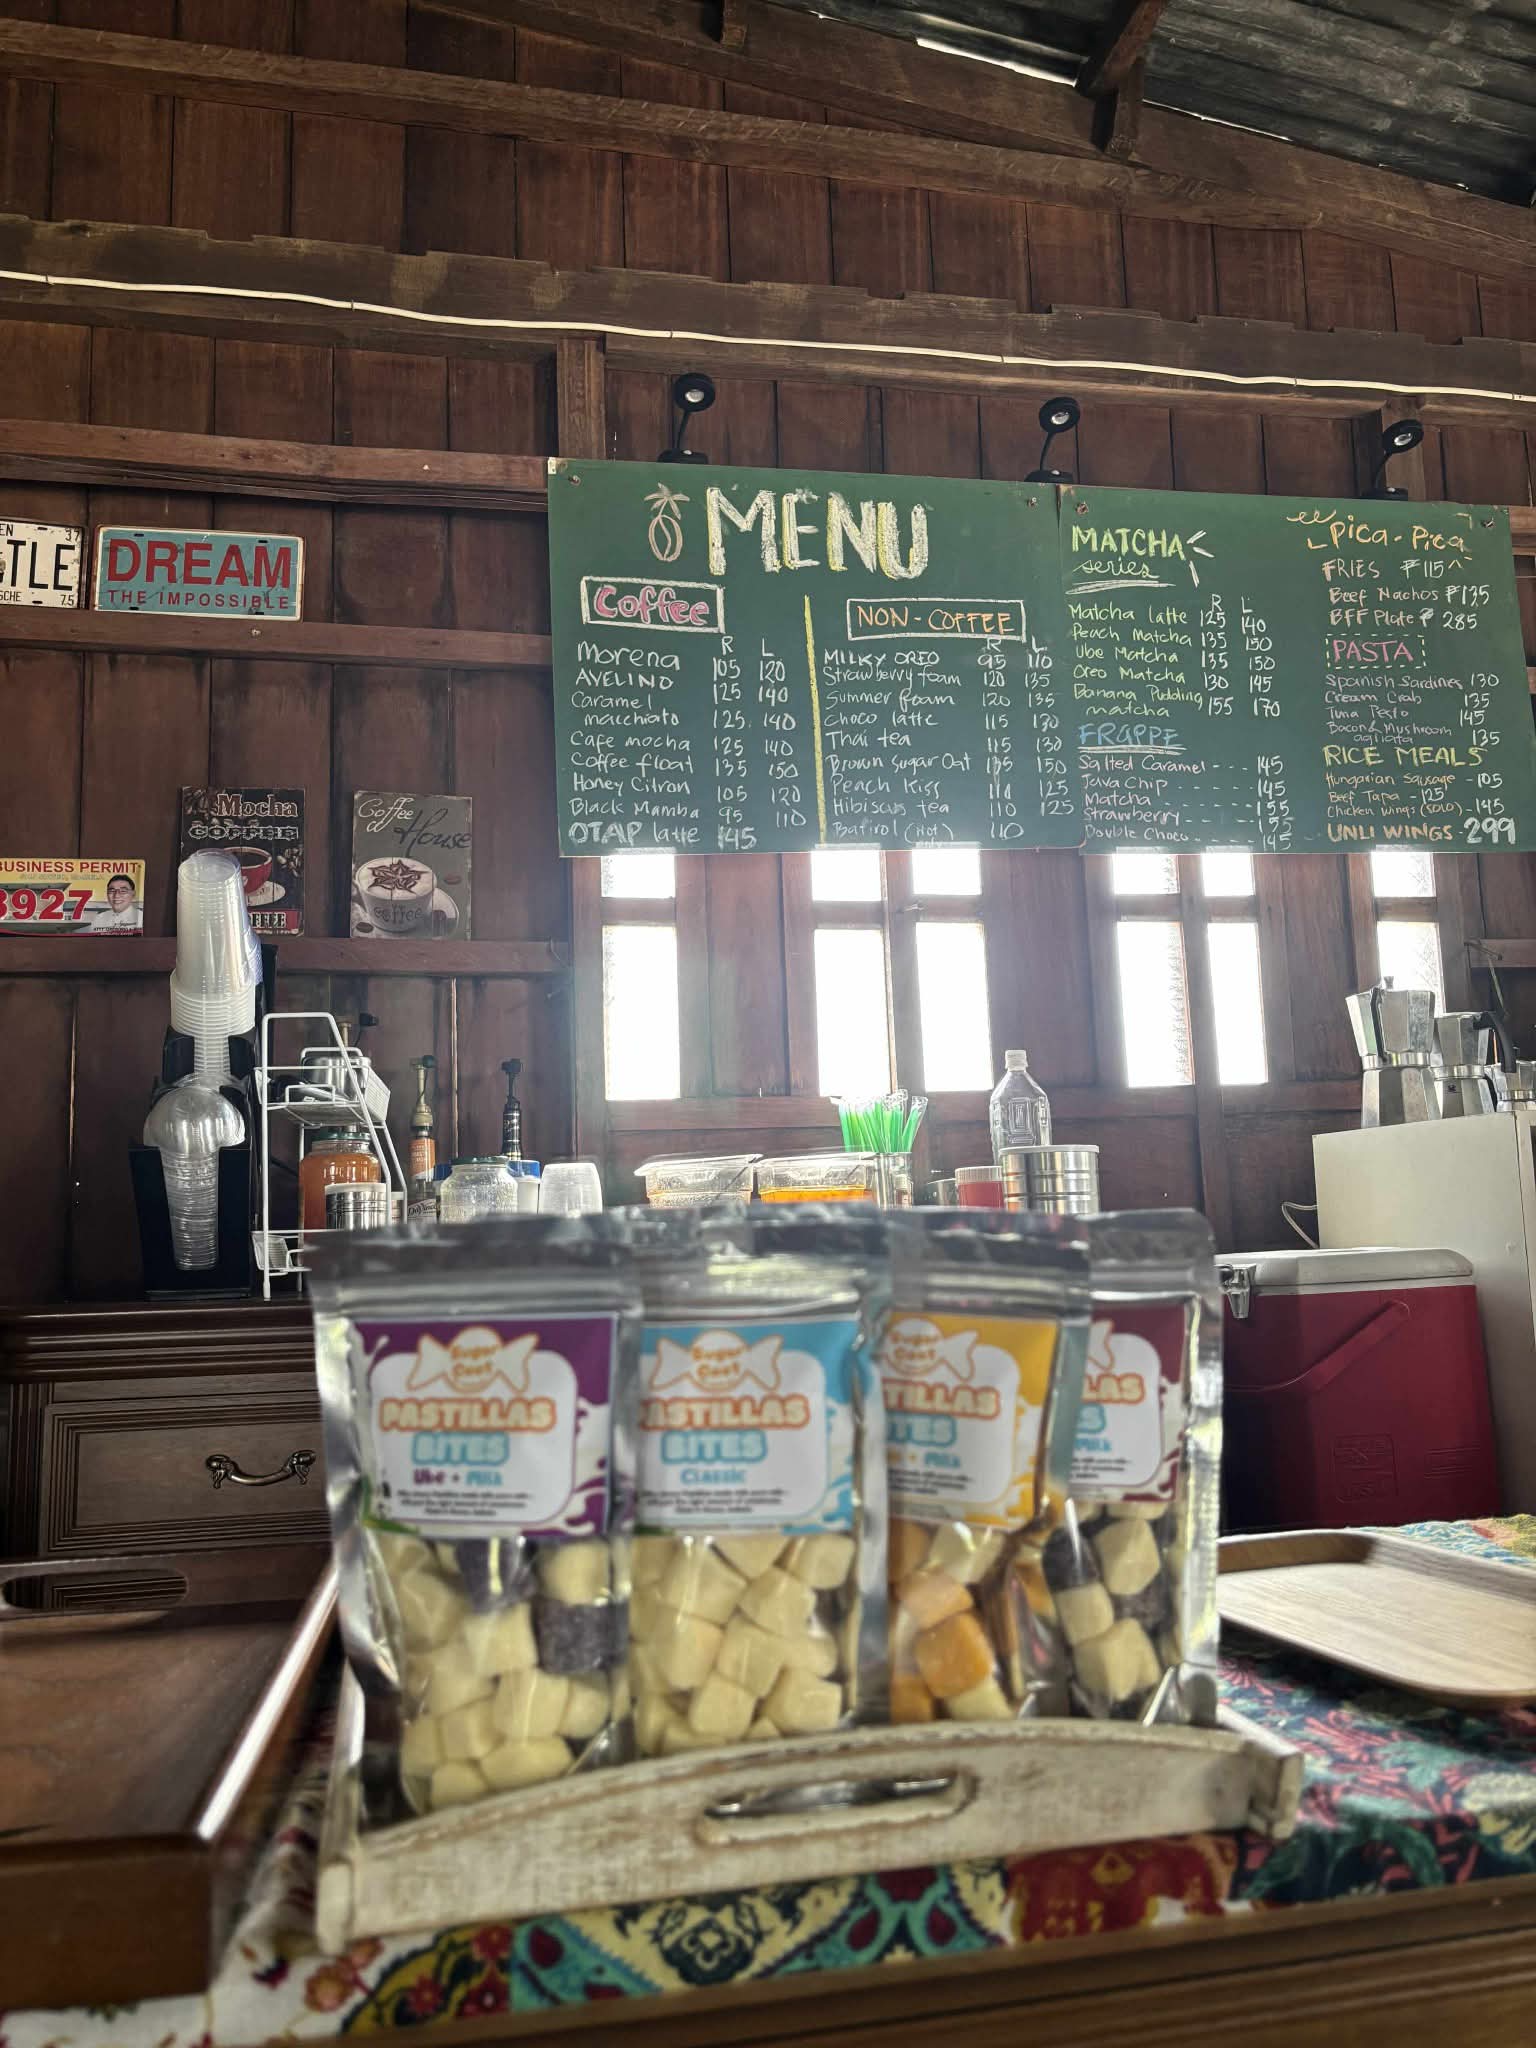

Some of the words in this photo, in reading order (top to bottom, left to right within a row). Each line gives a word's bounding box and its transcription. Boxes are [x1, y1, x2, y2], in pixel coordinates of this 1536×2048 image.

[65, 527, 80, 541] 37
[706, 487, 929, 580] MENU
[1072, 525, 1186, 561] MATCHA
[0, 539, 76, 592] TLE
[107, 538, 291, 588] DREAM
[1073, 558, 1160, 579] series
[1322, 559, 1379, 581] FRIES
[60, 594, 75, 606] 75
[107, 589, 146, 603] THE
[159, 592, 289, 609] IMPOSSIBLE
[593, 586, 710, 626] Coffee
[1330, 587, 1368, 606] Beef
[1378, 587, 1439, 602] Nachos
[1068, 604, 1135, 621] Matcha
[1149, 606, 1187, 624] latte
[1200, 610, 1226, 628] 125
[1242, 616, 1266, 635] 140
[1330, 609, 1369, 626] BFF
[1375, 609, 1414, 626] Plate
[1443, 612, 1477, 629] 285
[722, 636, 733, 655] R
[1072, 623, 1120, 642] Peach
[1132, 628, 1192, 647] Matcha
[1201, 631, 1227, 651] 135
[1246, 637, 1272, 652] 150
[577, 641, 680, 671] Morena
[713, 657, 740, 680] 105
[759, 660, 785, 683] 120
[824, 649, 885, 666] MILKY
[895, 652, 939, 666] OREO
[978, 654, 1006, 669] 95
[1027, 654, 1052, 669] 110
[1076, 645, 1104, 659] Ube
[1114, 646, 1178, 663] Matcha
[1202, 651, 1229, 670] 135
[1249, 655, 1275, 671] 150
[1333, 639, 1413, 662] PASTA
[576, 668, 673, 689] AVELINO
[713, 683, 740, 704] 125
[758, 686, 787, 706] 140
[823, 666, 913, 689] Strawberry
[918, 666, 962, 687] foam
[984, 672, 1005, 687] 120
[1025, 672, 1050, 689] 135
[1073, 667, 1107, 679] Oreo
[1120, 666, 1186, 685] Matcha
[1203, 674, 1229, 691] 130
[1250, 676, 1272, 693] 145
[1326, 675, 1395, 692] Spanish
[1400, 675, 1463, 689] Sardines
[1470, 673, 1499, 687] 130
[571, 691, 652, 710] Caramel
[826, 691, 891, 710] Summer
[982, 693, 1010, 707] 120
[1028, 693, 1055, 708] 135
[1073, 683, 1137, 701] Banana
[1150, 687, 1203, 710] Pudding
[1209, 696, 1233, 716] 155
[1254, 696, 1280, 717] 170
[1085, 704, 1170, 717] matcha
[1324, 692, 1377, 703] Cream
[1387, 691, 1422, 705] Crab
[1464, 693, 1490, 708] 135
[713, 710, 745, 729] 125
[764, 712, 796, 730] 140
[892, 712, 938, 726] latte
[985, 714, 1008, 729] 115
[1033, 714, 1059, 732] 130
[1327, 707, 1359, 719] Tuna
[1371, 707, 1409, 719] Pesto
[1460, 709, 1485, 727] 145
[826, 731, 868, 749] Thai
[878, 728, 911, 746] tea
[988, 737, 1011, 752] 115
[1037, 737, 1062, 752] 130
[1079, 723, 1182, 747] FRAPPE
[1384, 723, 1452, 736] Mushroom
[1473, 729, 1501, 747] 135
[571, 731, 615, 753] Cafe
[625, 735, 690, 751] mocha
[714, 736, 743, 756] 125
[765, 739, 793, 755] 140
[571, 752, 630, 773] Coffee
[636, 753, 693, 777] float
[716, 757, 746, 777] 135
[769, 762, 798, 779] 150
[826, 754, 884, 774] Brown
[942, 752, 971, 771] Oat
[1037, 757, 1067, 773] 150
[1079, 754, 1133, 772] Salted
[1142, 757, 1206, 774] Caramel
[1258, 755, 1284, 774] 145
[1322, 745, 1383, 766] RICE
[1395, 747, 1488, 766] MEALS
[573, 772, 624, 796] Honey
[632, 777, 690, 794] Citron
[718, 786, 747, 803] 105
[771, 786, 800, 806] 120
[832, 773, 891, 796] Peach
[1040, 779, 1069, 798] 125
[1082, 774, 1120, 789] Java
[1124, 774, 1167, 792] Chip
[1258, 780, 1286, 798] 145
[1326, 773, 1395, 786] Hungarian
[216, 794, 299, 817] Mocha
[833, 798, 905, 817] Hibiscus
[917, 799, 950, 818] tea
[991, 802, 1016, 817] 110
[1041, 800, 1074, 816] 125
[1085, 792, 1152, 807] Matcha
[1257, 800, 1289, 817] 155
[1328, 791, 1354, 804] Beef
[1364, 791, 1400, 804] Tapa
[358, 798, 414, 833] Coffee
[570, 798, 624, 817] Black
[634, 802, 699, 819] Mamba
[719, 807, 743, 824] 95
[776, 809, 806, 827] 110
[1083, 807, 1180, 826] Strawberry
[1327, 805, 1373, 817] Chicken
[188, 825, 299, 841] COFFEE
[393, 808, 472, 858] House
[569, 822, 643, 845] OTAP
[653, 822, 700, 843] latte
[718, 823, 757, 849] 145
[991, 823, 1025, 839] 110
[1327, 824, 1375, 842] UNLI
[1384, 824, 1454, 841] WINGS
[80, 861, 138, 874] PERMIT
[882, 1377, 1000, 1421] TILLAS
[378, 1397, 557, 1432] PASTILLAS
[640, 1392, 810, 1431] ASTILLAS
[411, 1431, 510, 1466] BITES
[662, 1430, 768, 1464] BITES
